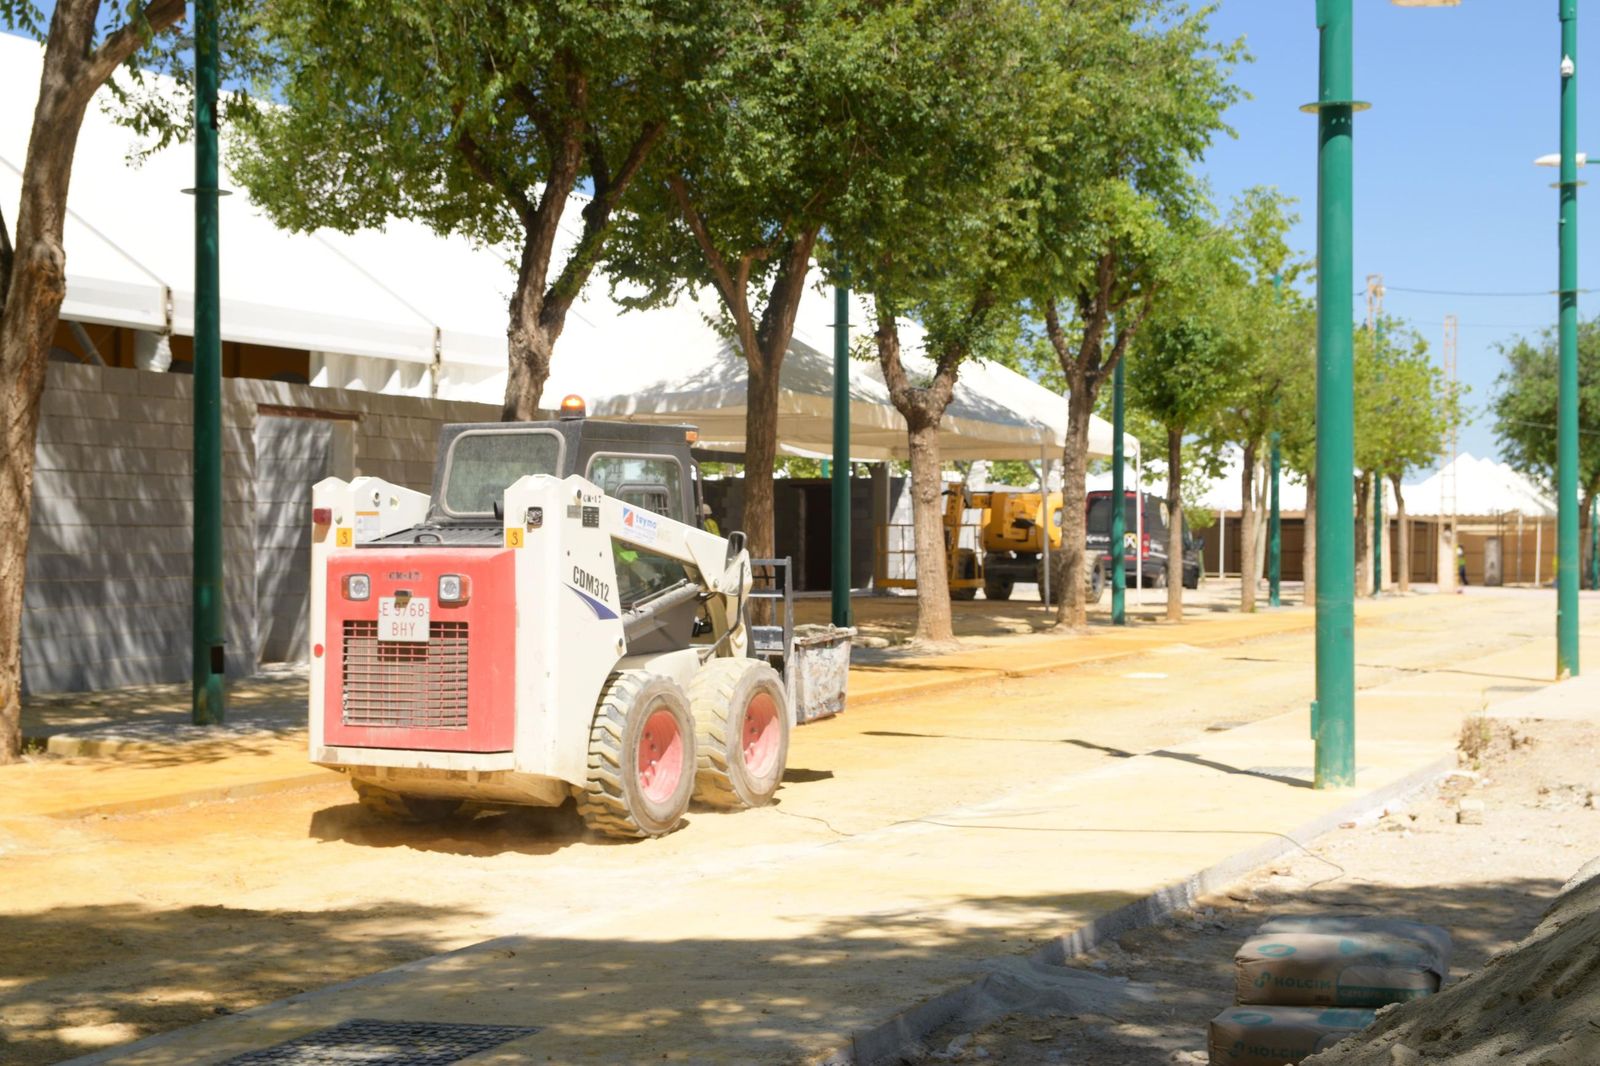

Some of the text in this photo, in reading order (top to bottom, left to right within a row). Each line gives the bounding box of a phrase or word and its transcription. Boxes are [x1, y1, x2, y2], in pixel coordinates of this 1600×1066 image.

[572, 565, 610, 602] CDM312
[382, 602, 425, 617] E 9768
[392, 622, 415, 636] BHY
[1274, 977, 1331, 989] HOLCIM
